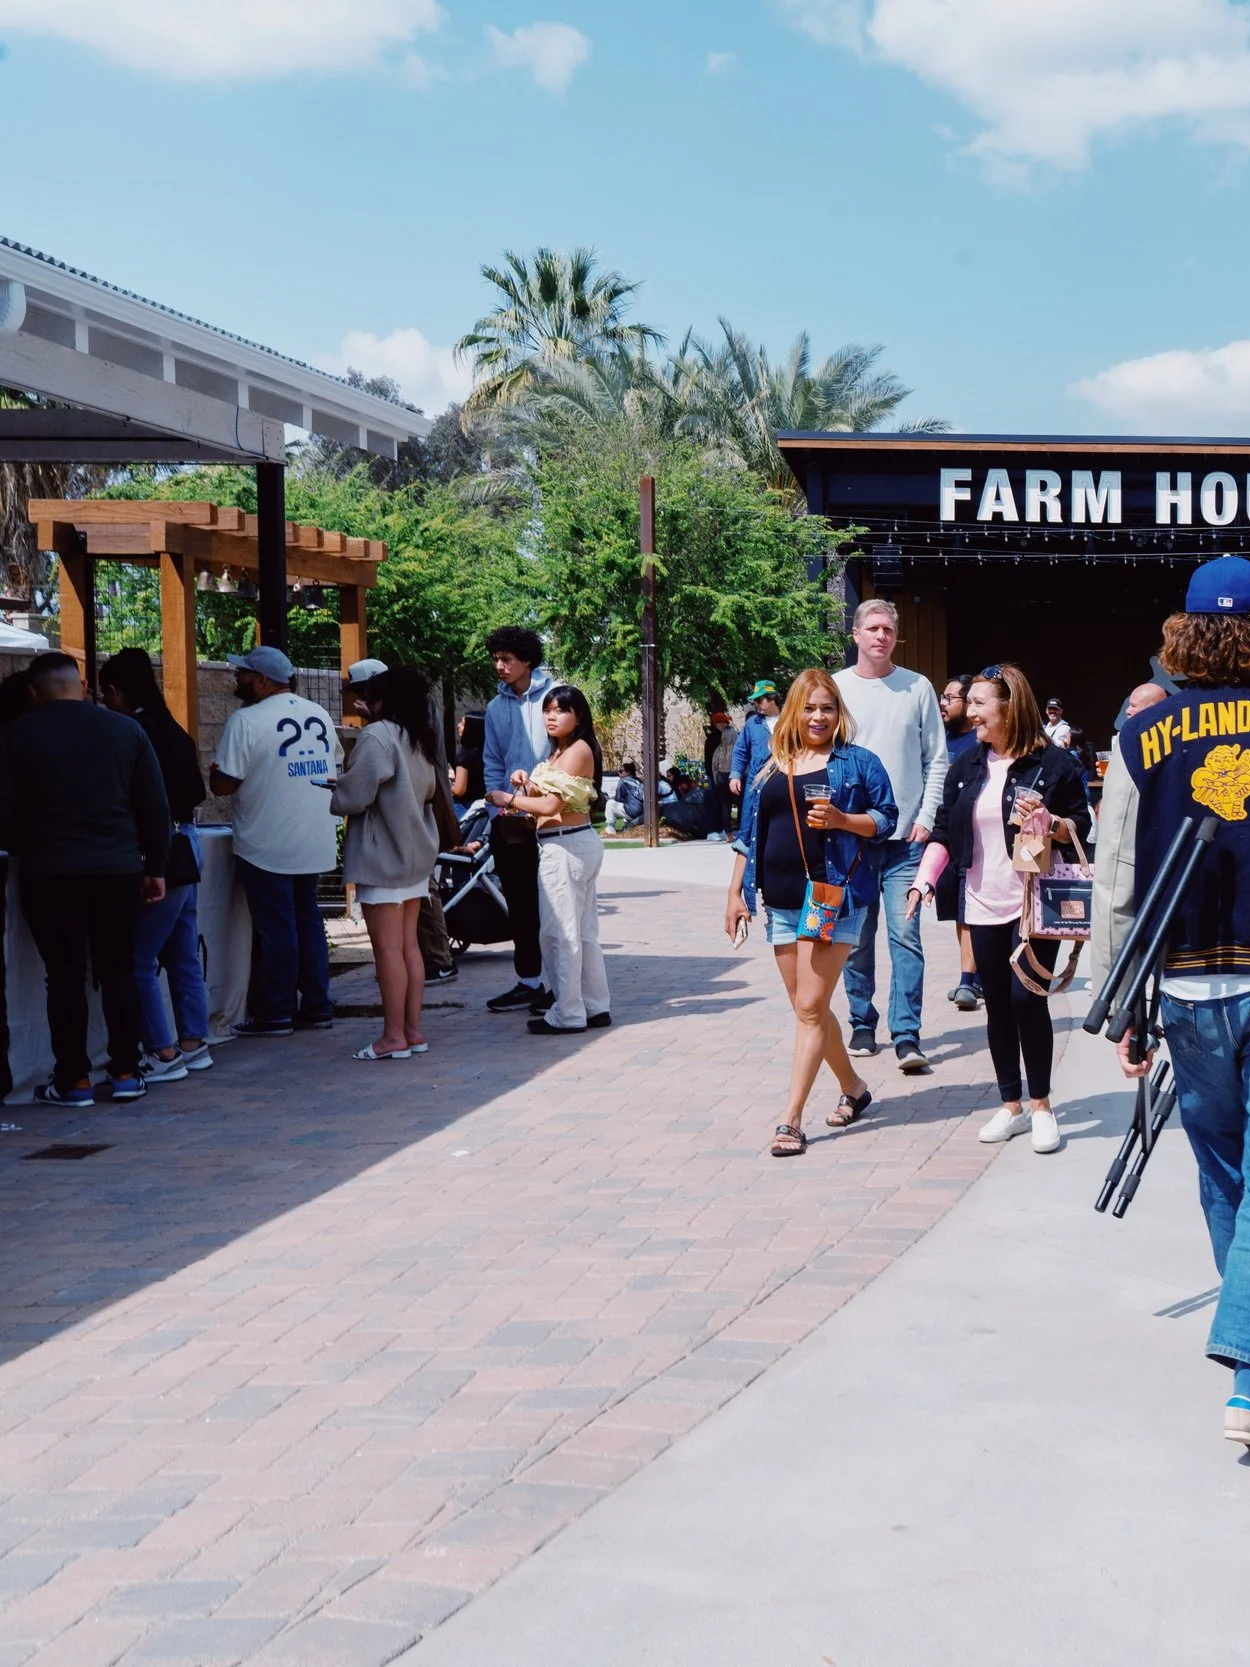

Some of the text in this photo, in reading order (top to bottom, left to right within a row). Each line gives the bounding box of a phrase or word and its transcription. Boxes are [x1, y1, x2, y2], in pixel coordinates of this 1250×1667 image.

[939, 467, 1122, 524] FARM
[277, 716, 330, 757] 23
[287, 760, 329, 777] SANTANA
